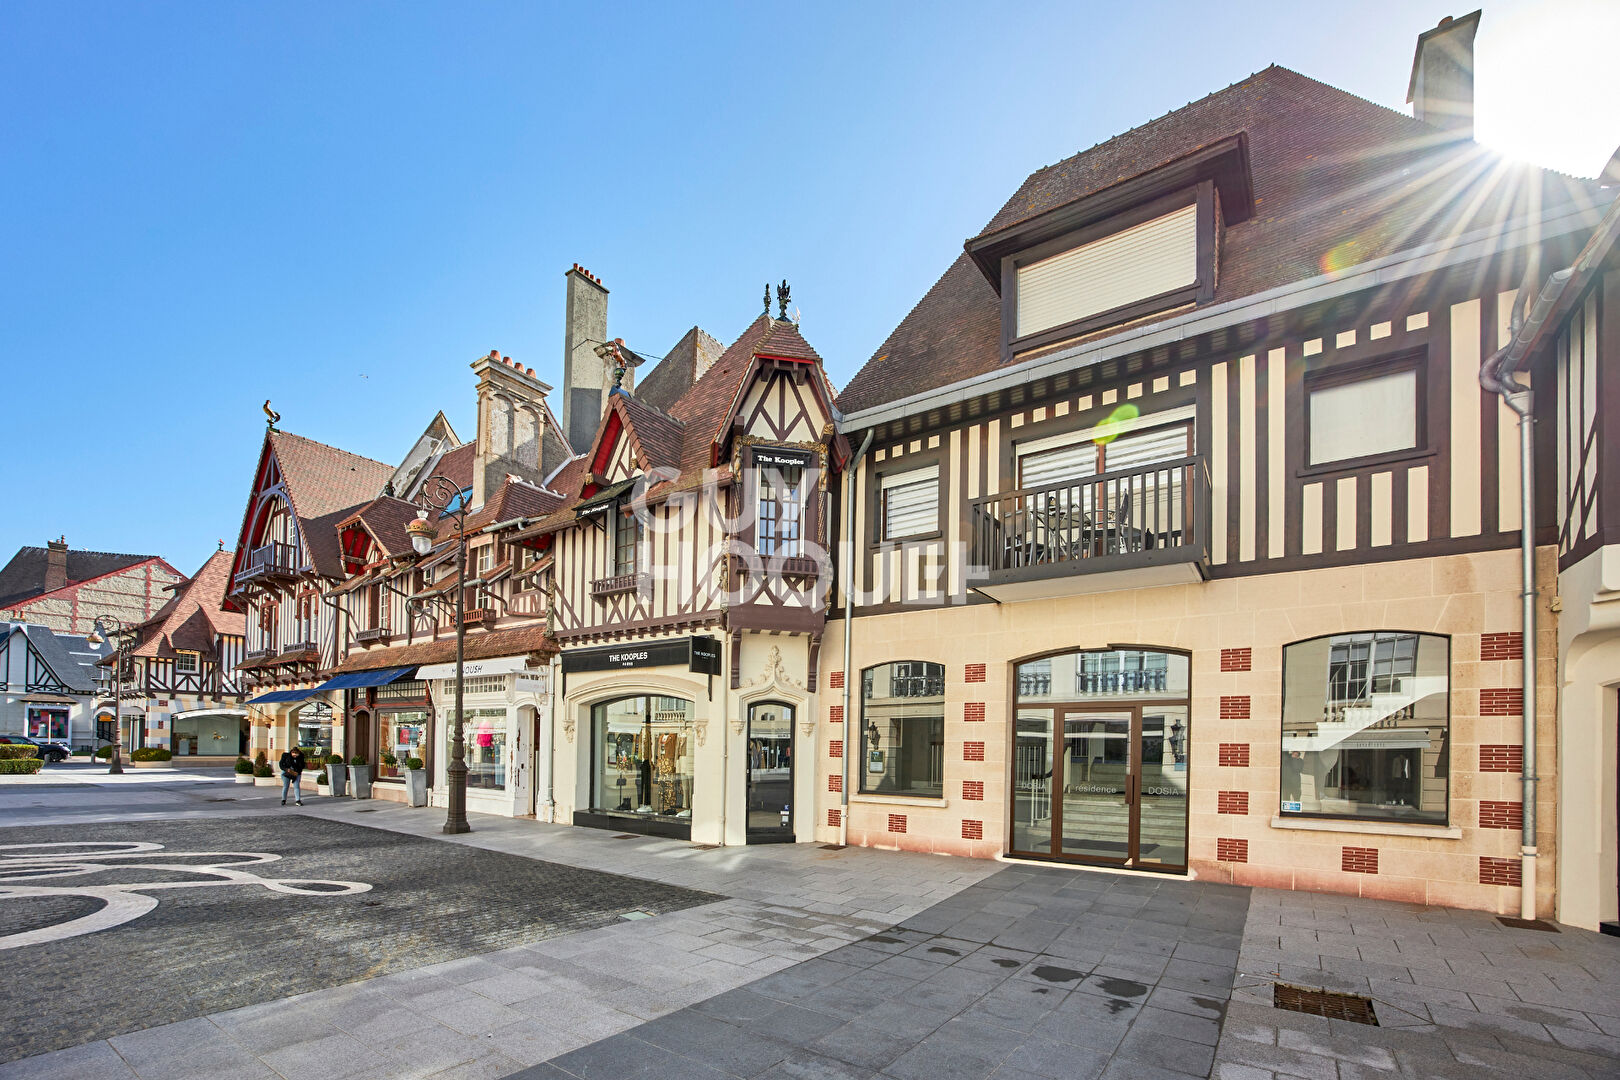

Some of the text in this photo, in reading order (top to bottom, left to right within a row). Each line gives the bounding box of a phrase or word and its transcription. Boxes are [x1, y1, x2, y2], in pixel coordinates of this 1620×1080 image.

[774, 456, 804, 465] Kooples
[609, 652, 648, 662] THE KOOPLES
[452, 665, 483, 674] MOUSH
[1075, 784, 1179, 796] résidence DOSIA
